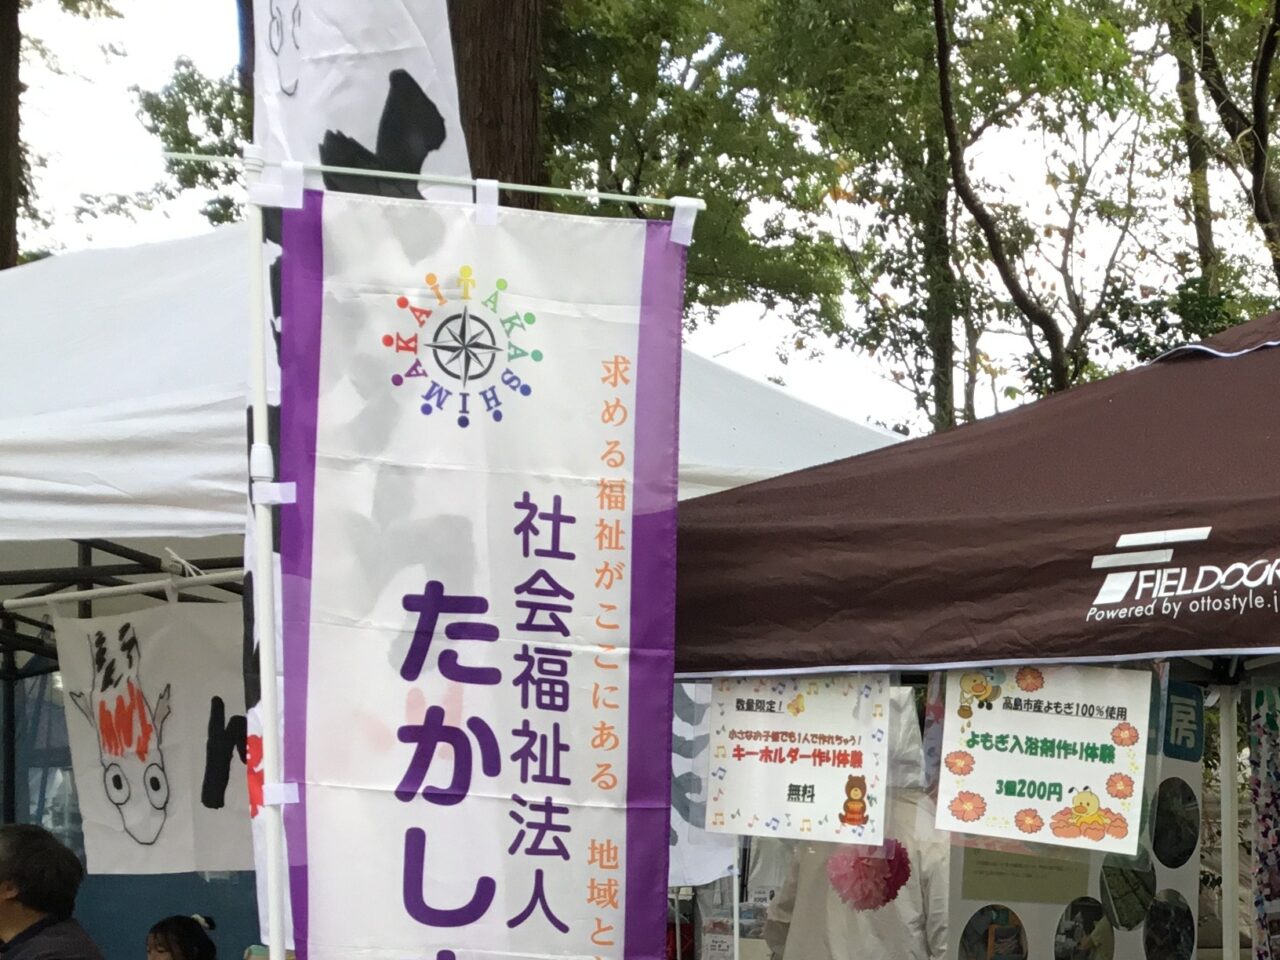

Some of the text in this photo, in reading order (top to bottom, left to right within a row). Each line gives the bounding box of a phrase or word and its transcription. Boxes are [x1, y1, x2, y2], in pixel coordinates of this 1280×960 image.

[590, 355, 631, 792] 求める福祉がここにある
[1086, 598, 1156, 622] Powered
[1161, 597, 1182, 619] by
[507, 490, 576, 933] 社会福祉法人
[736, 698, 783, 713] 数量限定！
[1002, 695, 1127, 721] 高島市産よもぎ100%使用
[732, 744, 863, 769] キーホルダー作り体験
[966, 731, 1116, 764] よもぎ入浴剤作り体験
[786, 783, 815, 803] 無料
[995, 778, 1063, 802] 3個200円
